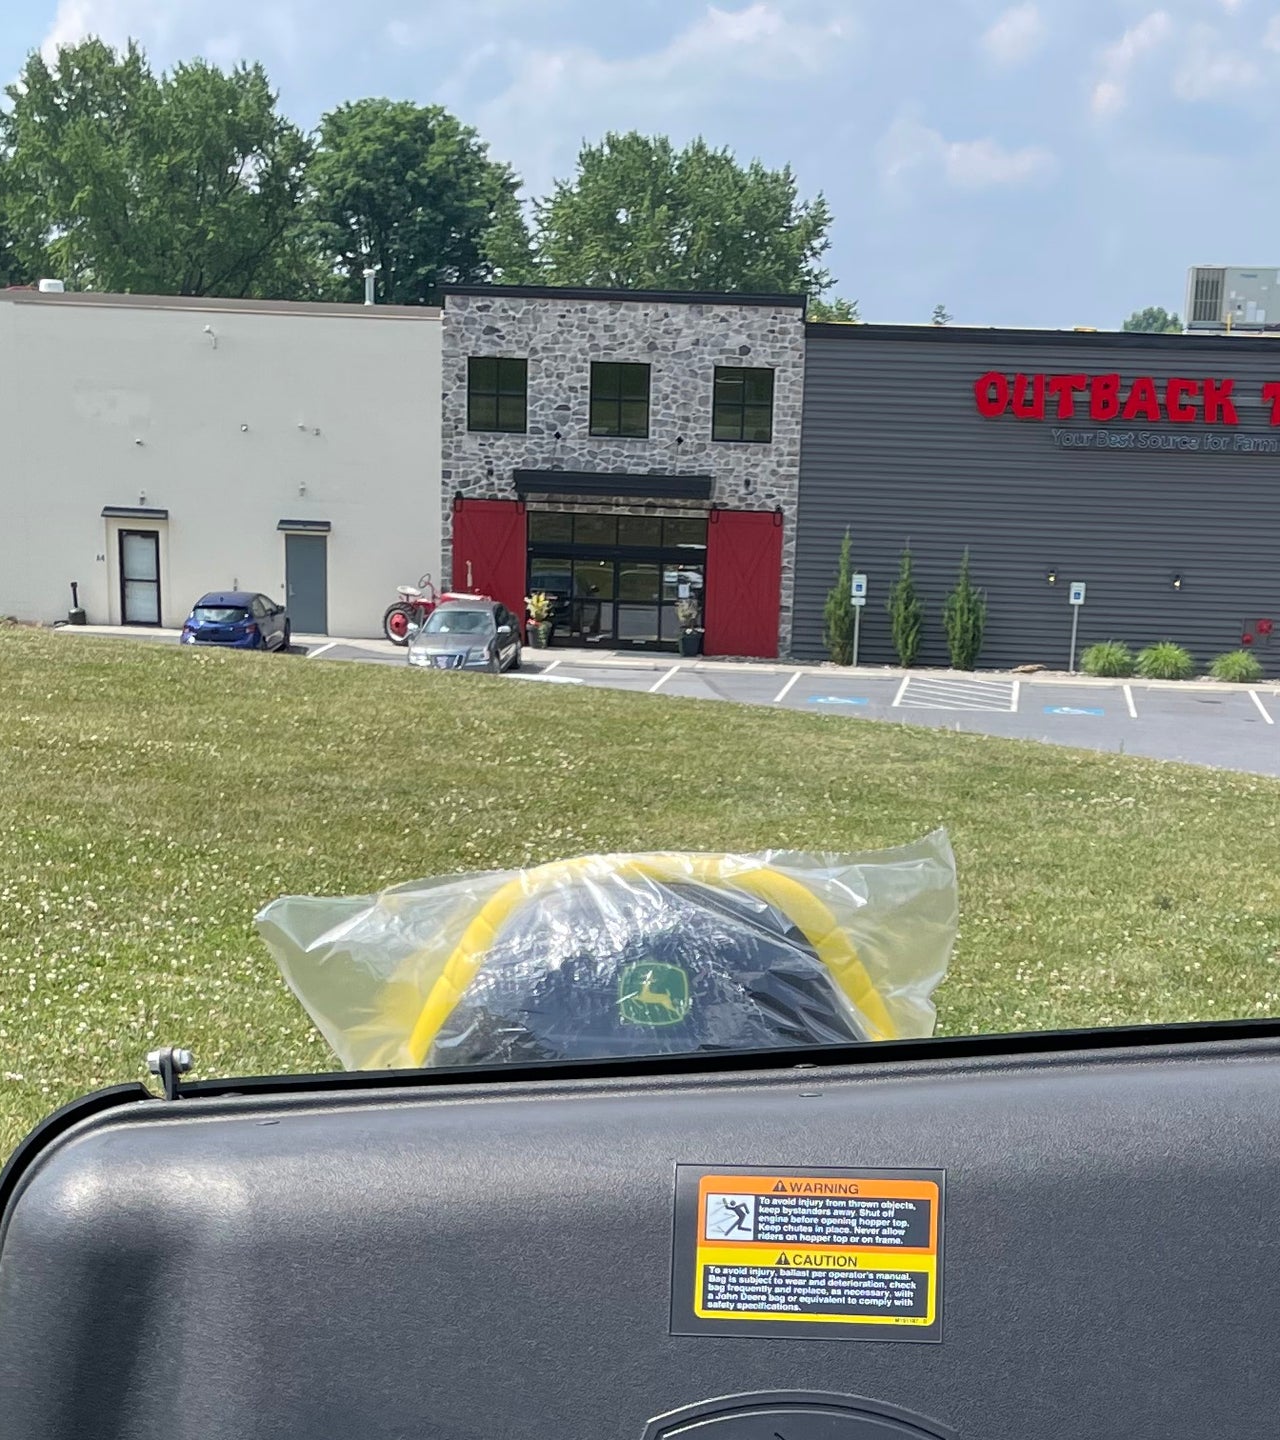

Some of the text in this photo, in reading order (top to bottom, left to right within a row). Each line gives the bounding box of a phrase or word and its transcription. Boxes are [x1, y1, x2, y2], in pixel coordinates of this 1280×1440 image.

[973, 371, 1239, 424] OUTBACK
[1052, 428, 1093, 447] Your
[1096, 430, 1135, 448] Best
[1137, 431, 1200, 450] Source
[1204, 433, 1230, 451] for
[1233, 433, 1277, 452] Farm
[789, 1182, 859, 1195] WARNING
[759, 1196, 917, 1211] To avoid injury from thrown objects,
[759, 1205, 780, 1214] keep
[782, 1206, 831, 1215] bystanders
[859, 1208, 881, 1217] Shut
[882, 1209, 895, 1217] off
[758, 1215, 910, 1228] engine before opening hopper top.
[758, 1223, 906, 1236] Keep chutes in place. Never allow
[758, 1232, 784, 1241] riders
[800, 1233, 831, 1243] hopper
[832, 1234, 848, 1244] top
[861, 1236, 873, 1244] on
[875, 1236, 904, 1245] frame.
[792, 1254, 858, 1267] CAUTION
[708, 1266, 721, 1274] To
[722, 1267, 747, 1275] avoid
[780, 1269, 810, 1277] ballast
[811, 1271, 827, 1279] per
[828, 1271, 874, 1279] operator's
[708, 1275, 726, 1284] Bag
[728, 1275, 737, 1283] is
[738, 1276, 772, 1285] subject
[785, 1278, 807, 1286] wear
[827, 1279, 888, 1289] deterioration,
[889, 1281, 917, 1289] check
[707, 1283, 725, 1293] bag
[727, 1284, 773, 1293] frequently
[774, 1285, 792, 1293] and
[894, 1289, 914, 1298] with
[707, 1301, 802, 1311] safety specifications.
[715, 1292, 739, 1300] John
[740, 1293, 767, 1301] Deere
[768, 1294, 786, 1304] bag
[799, 1295, 846, 1305] equivalent
[859, 1297, 892, 1308] comply
[894, 1298, 914, 1307] with
